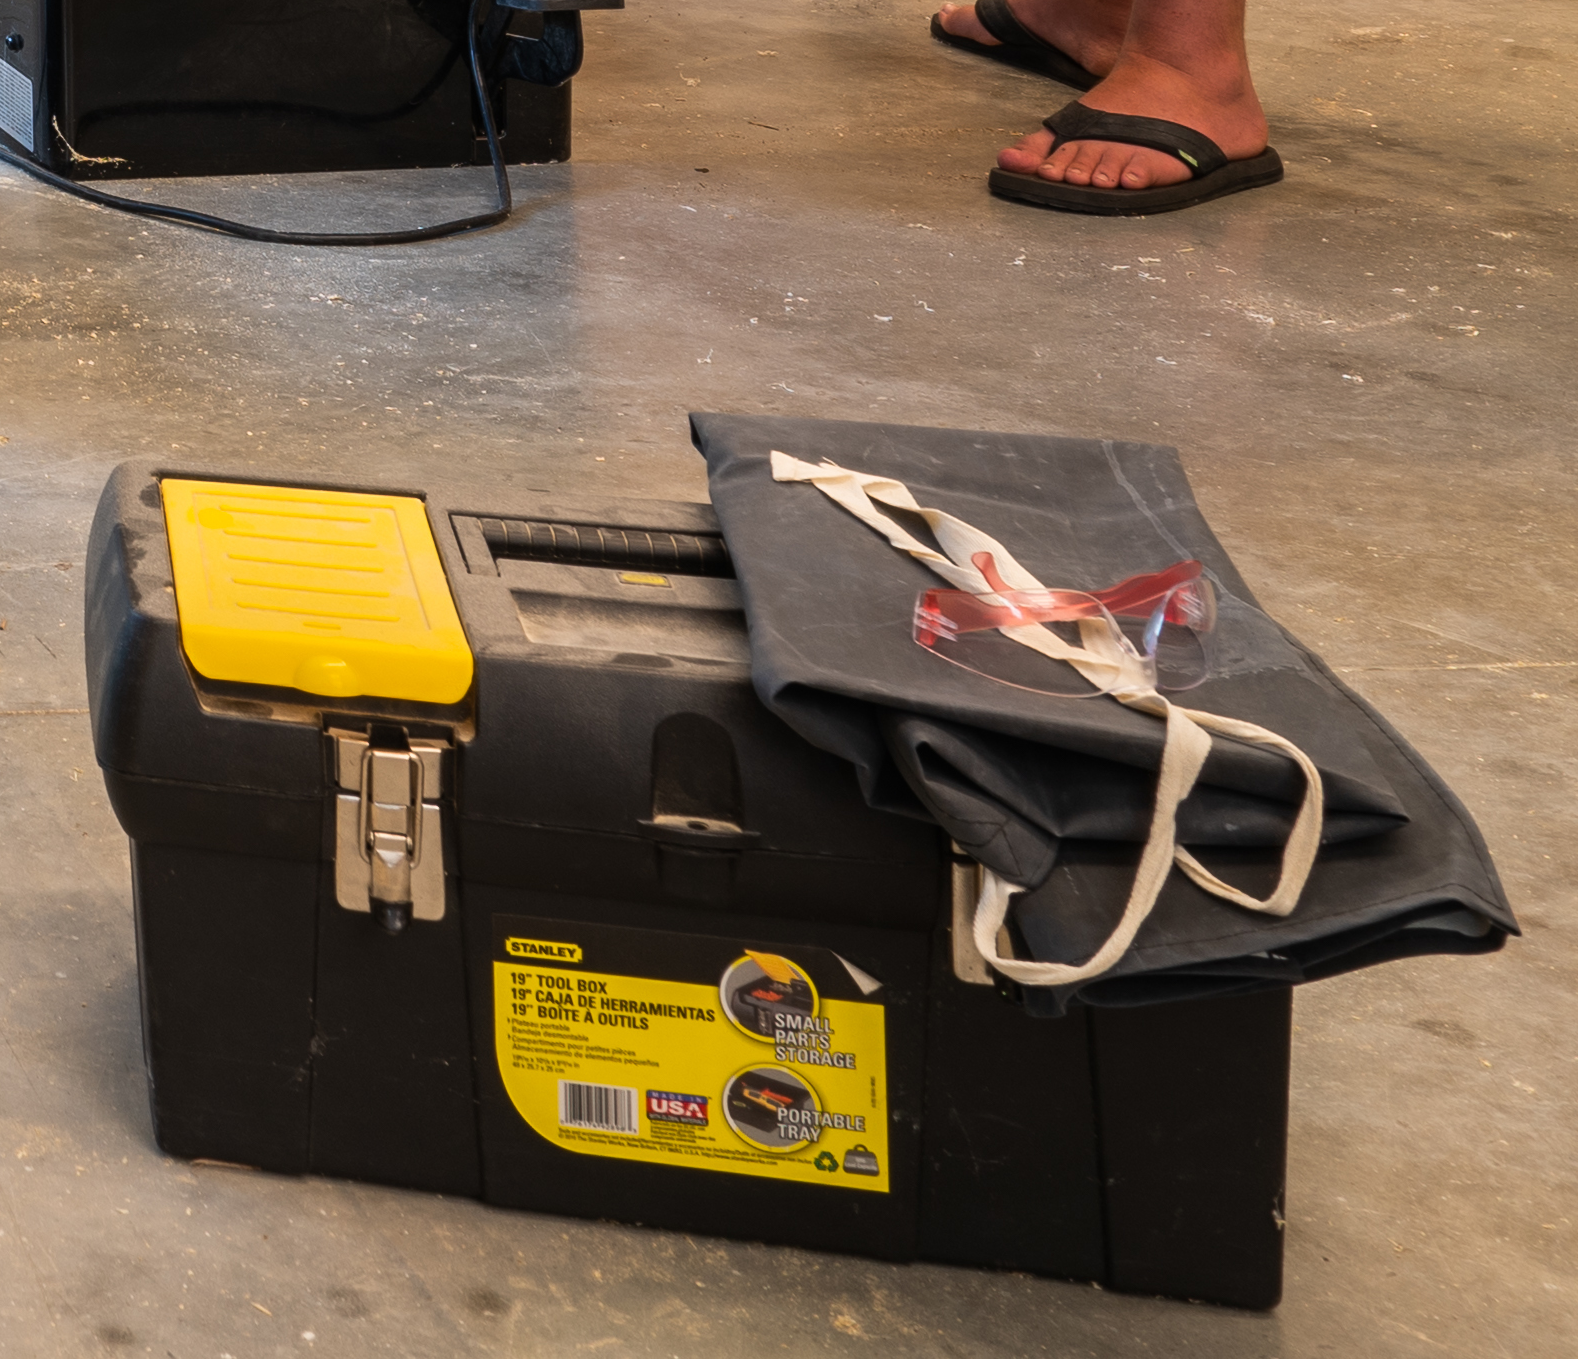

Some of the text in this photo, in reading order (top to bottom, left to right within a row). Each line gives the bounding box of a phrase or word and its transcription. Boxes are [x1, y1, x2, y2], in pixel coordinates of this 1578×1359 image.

[511, 941, 577, 958] STANLEY
[536, 974, 574, 991] TOOL
[577, 980, 608, 995] BOX
[535, 990, 574, 1008] CAJA
[578, 995, 597, 1009] DE
[601, 997, 716, 1023] HERRAMIENTAS
[598, 1013, 649, 1030] OUTILS
[774, 1013, 833, 1034] SMALL
[775, 1030, 830, 1050] PARTS
[775, 1046, 856, 1069] STORAGE
[651, 1091, 683, 1102] MADE
[650, 1098, 705, 1118] USA
[777, 1107, 865, 1132] PORTABLE
[777, 1123, 820, 1142] TRAY
